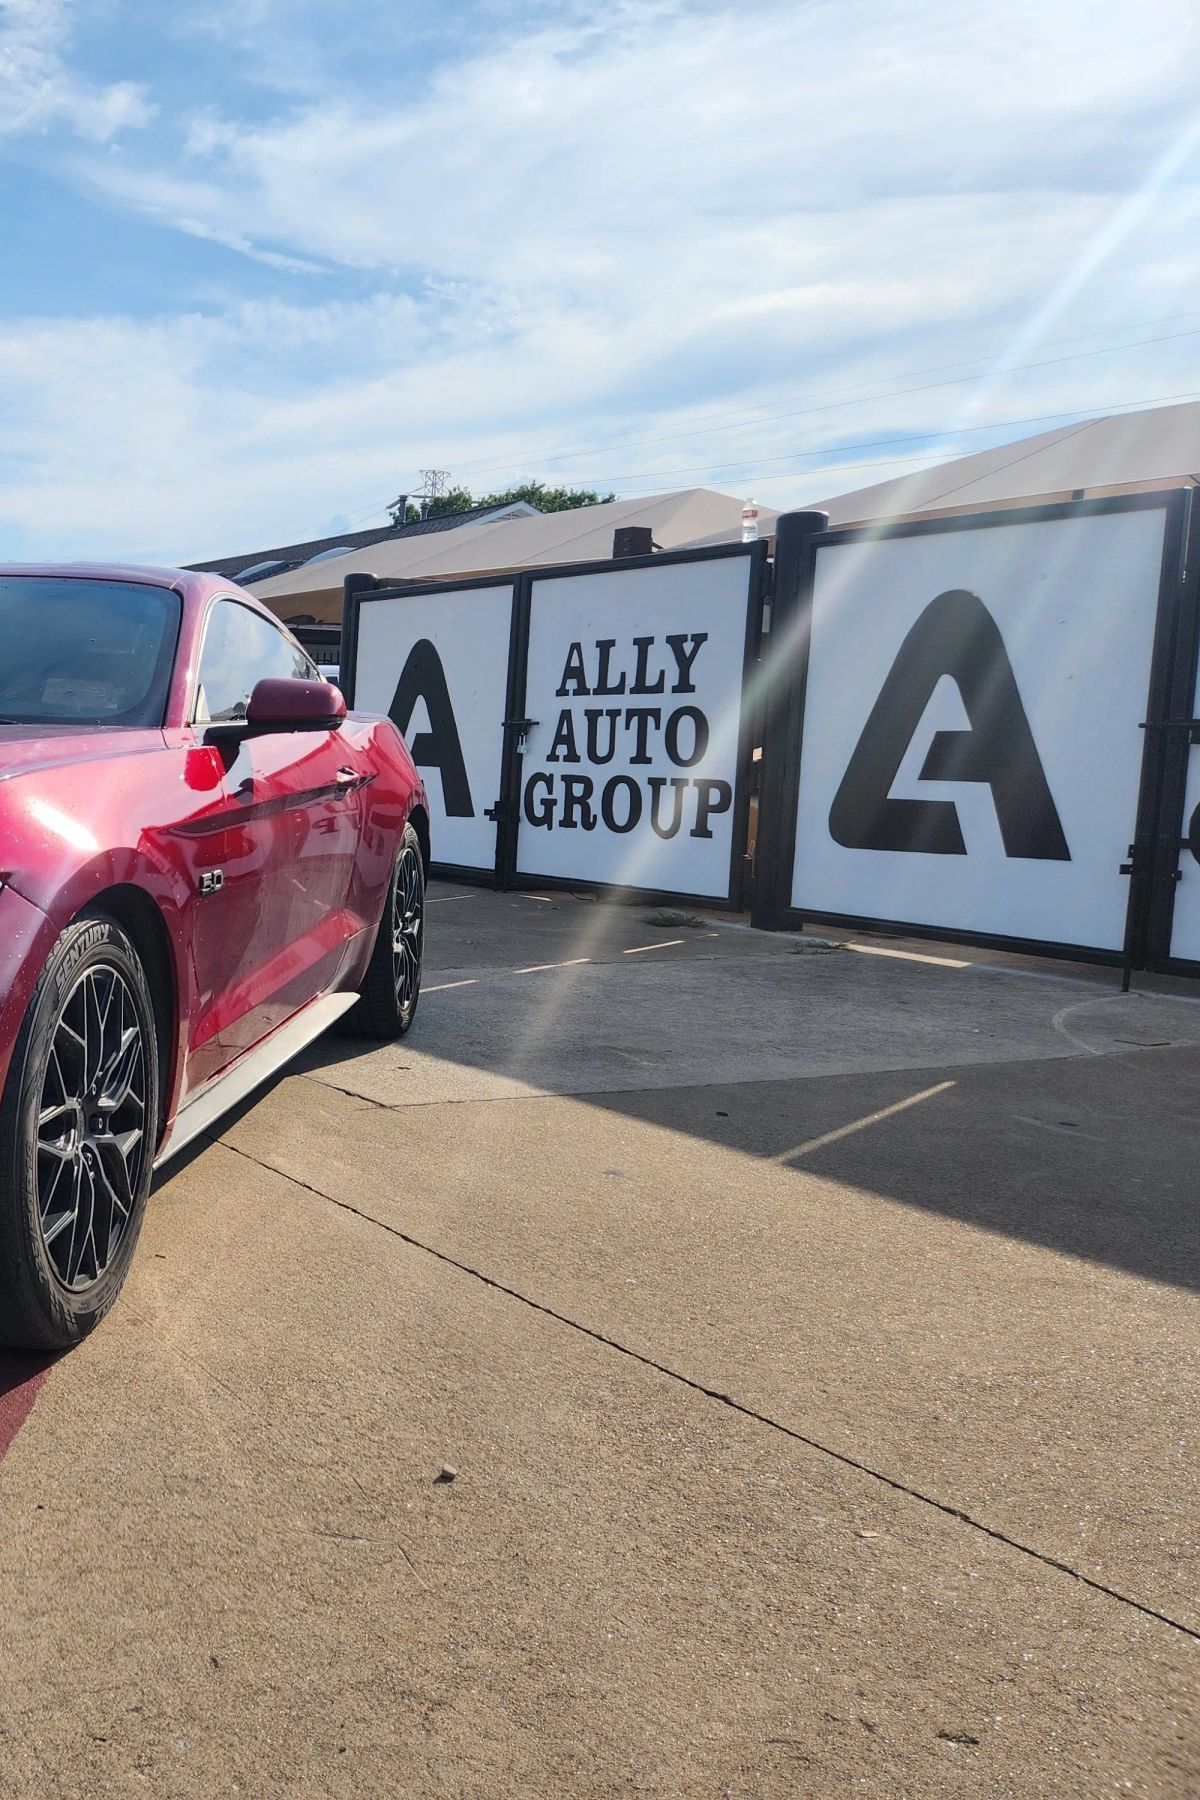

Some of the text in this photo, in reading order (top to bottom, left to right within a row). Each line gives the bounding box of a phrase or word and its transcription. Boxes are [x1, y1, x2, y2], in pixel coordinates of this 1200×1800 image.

[555, 632, 708, 697] ALLY
[546, 705, 710, 768] AUTO
[524, 771, 733, 840] GROUP
[55, 923, 110, 990] SENTURY
